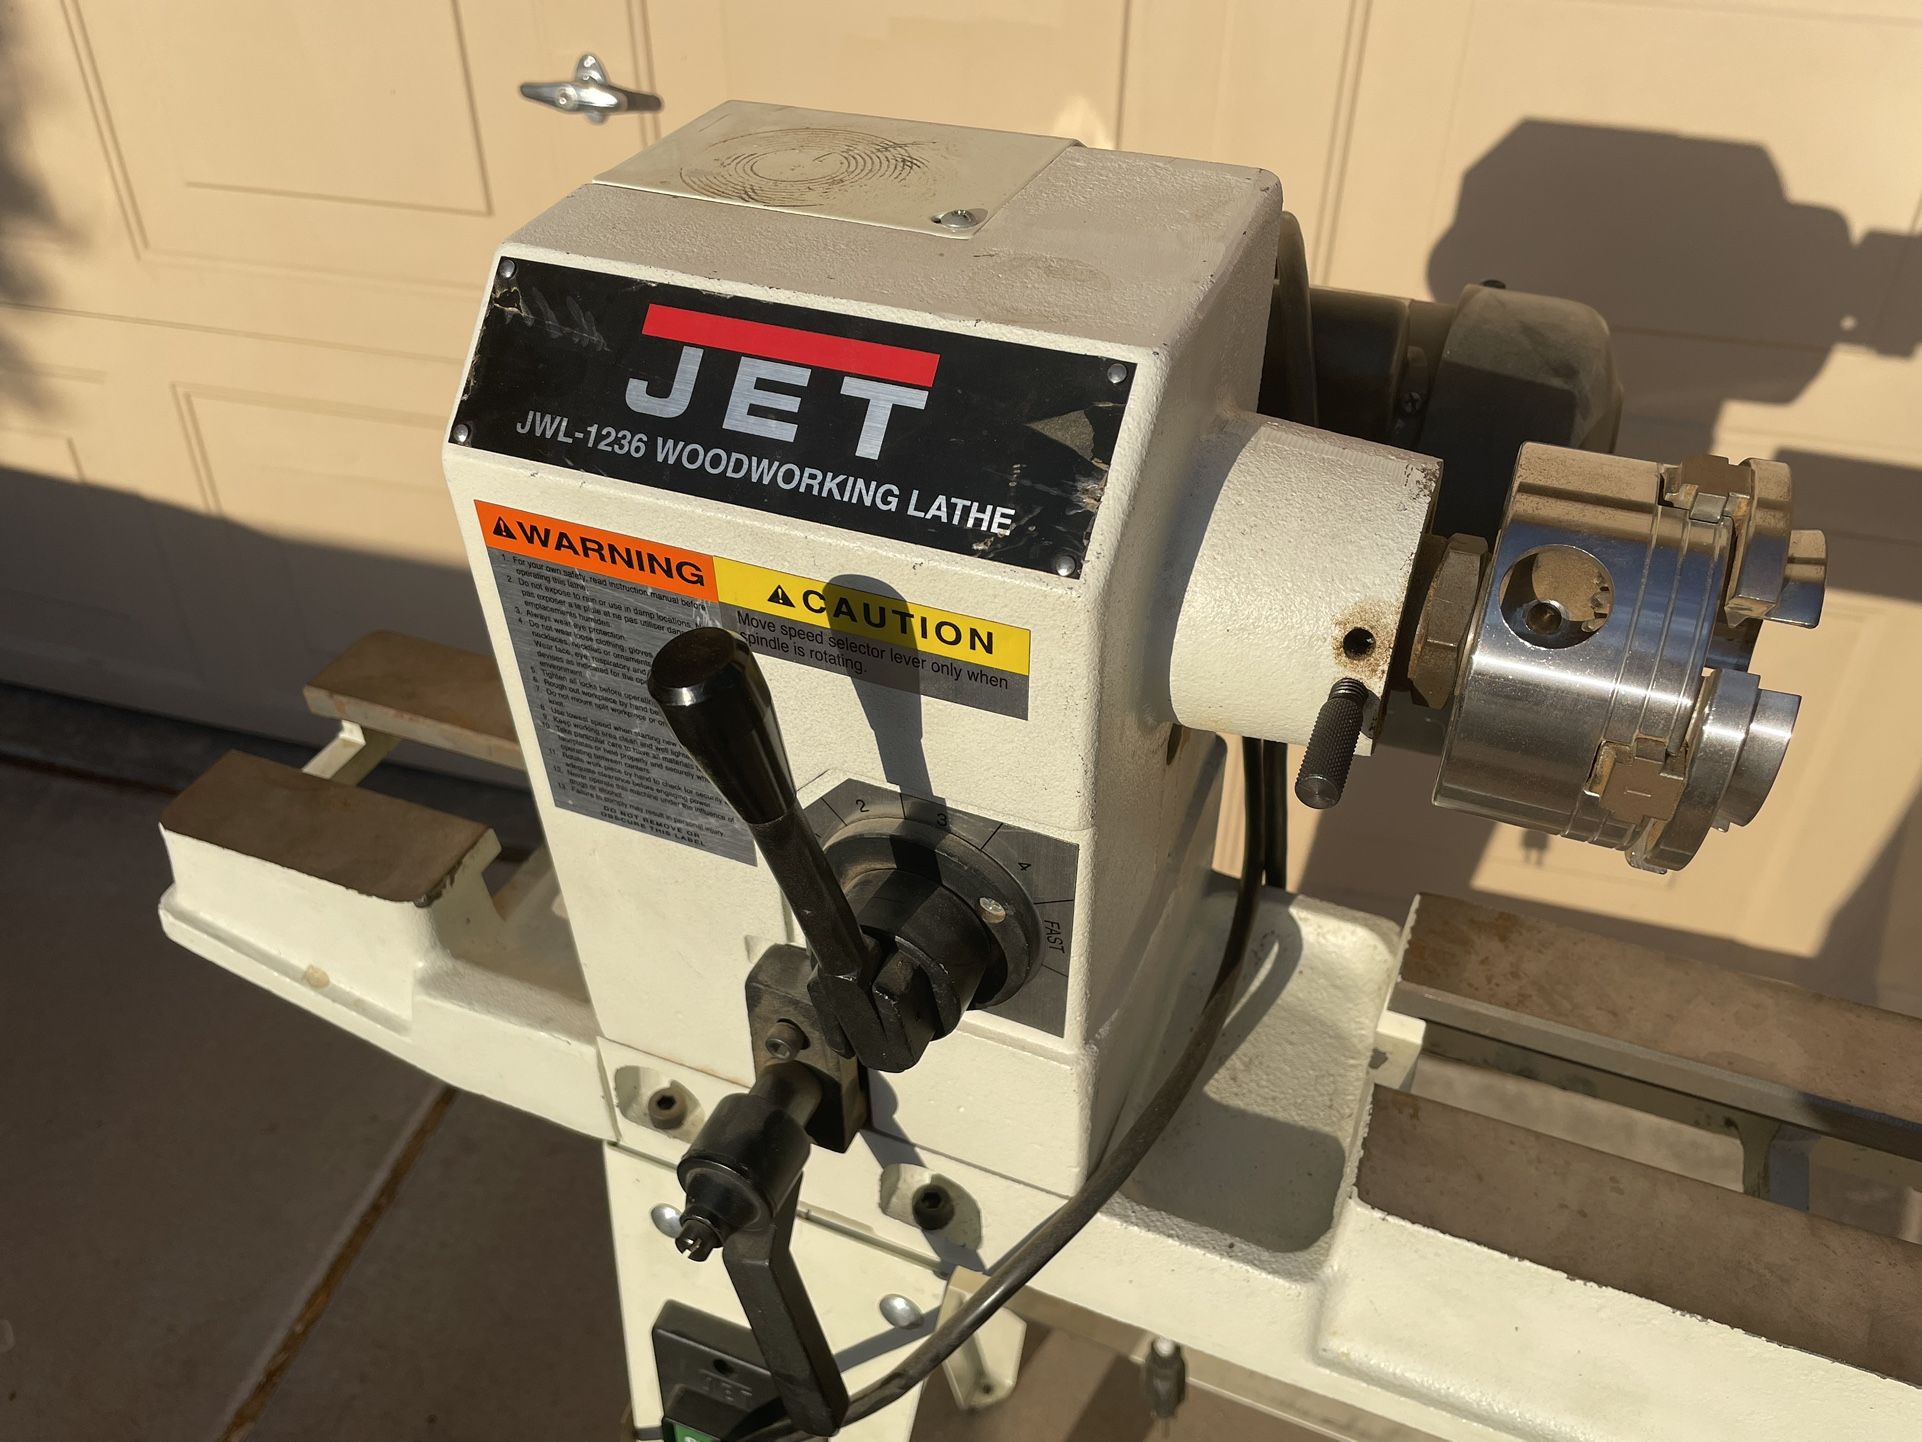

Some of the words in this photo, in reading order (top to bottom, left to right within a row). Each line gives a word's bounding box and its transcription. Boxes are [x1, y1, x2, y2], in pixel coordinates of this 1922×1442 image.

[624, 345, 929, 461] JET
[516, 410, 647, 458] JWL-1236
[656, 440, 899, 511] WOODWORKING
[906, 491, 1016, 535] LATHE
[515, 520, 706, 588] WARNING
[511, 555, 526, 566] For
[526, 560, 544, 571] your
[544, 564, 562, 575] own
[561, 569, 587, 583] safety,
[588, 575, 607, 586] read
[607, 578, 648, 596] instruction
[649, 590, 679, 604] manual
[680, 596, 706, 610] before
[515, 567, 552, 585] operating
[551, 575, 566, 586] this
[520, 589, 535, 599] pas
[535, 593, 567, 607] exposer
[582, 604, 602, 615] pluie
[623, 615, 638, 625] pas
[639, 618, 665, 631] utiliser
[523, 600, 578, 619] emplacements
[525, 608, 552, 624] Always
[552, 617, 571, 627] wear
[572, 622, 587, 632] eye
[529, 581, 544, 591] not
[543, 585, 571, 598] expose
[607, 601, 623, 611] use
[632, 605, 655, 621] damp
[655, 611, 692, 628] locations.
[802, 589, 994, 655] CAUTION
[530, 630, 571, 647] necklaces,
[540, 623, 554, 633] not
[553, 627, 573, 638] wear
[572, 630, 594, 643] loose
[594, 637, 627, 653] clothing,
[737, 611, 775, 633] Move
[781, 621, 824, 646] speed
[828, 634, 887, 659] selector
[890, 648, 927, 668] lever
[931, 659, 961, 681] only
[967, 669, 1009, 690] when
[740, 631, 790, 653] spindle
[794, 642, 805, 657] is
[809, 647, 868, 675] rotating.
[533, 639, 554, 652] Wear
[554, 644, 574, 658] face,
[591, 656, 632, 674] respiratory
[631, 666, 647, 676] and
[609, 668, 620, 678] for
[621, 671, 634, 682] the
[540, 669, 568, 683] Tighten
[568, 677, 577, 685] all
[578, 679, 598, 691] locks
[598, 684, 622, 697] before
[542, 678, 568, 692] Rough
[567, 686, 581, 695] out
[581, 690, 618, 705] workpiece
[628, 701, 648, 713] hand
[557, 692, 570, 701] not
[569, 696, 593, 707] mount
[593, 702, 609, 712] split
[609, 706, 647, 722] workpiece
[550, 706, 566, 717] Use
[565, 711, 589, 724] lowest
[590, 719, 612, 730] speed
[613, 725, 633, 736] when
[661, 738, 677, 748] new
[552, 716, 572, 729] Keep
[572, 722, 601, 737] working
[600, 730, 617, 740] area
[617, 735, 638, 746] clean
[638, 741, 654, 750] and
[654, 745, 669, 754] well
[555, 725, 573, 736] Take
[573, 731, 605, 745] particular
[606, 740, 623, 750] care
[632, 746, 650, 758] have
[651, 753, 661, 761] all
[661, 756, 694, 770] materials
[559, 744, 593, 760] operating
[602, 746, 619, 757] held
[619, 752, 648, 767] properly
[649, 761, 663, 770] and
[664, 765, 695, 780] securely
[856, 799, 870, 813] 2
[936, 812, 948, 827] 3
[1017, 861, 1032, 872] 4
[1044, 919, 1065, 954] FAST
